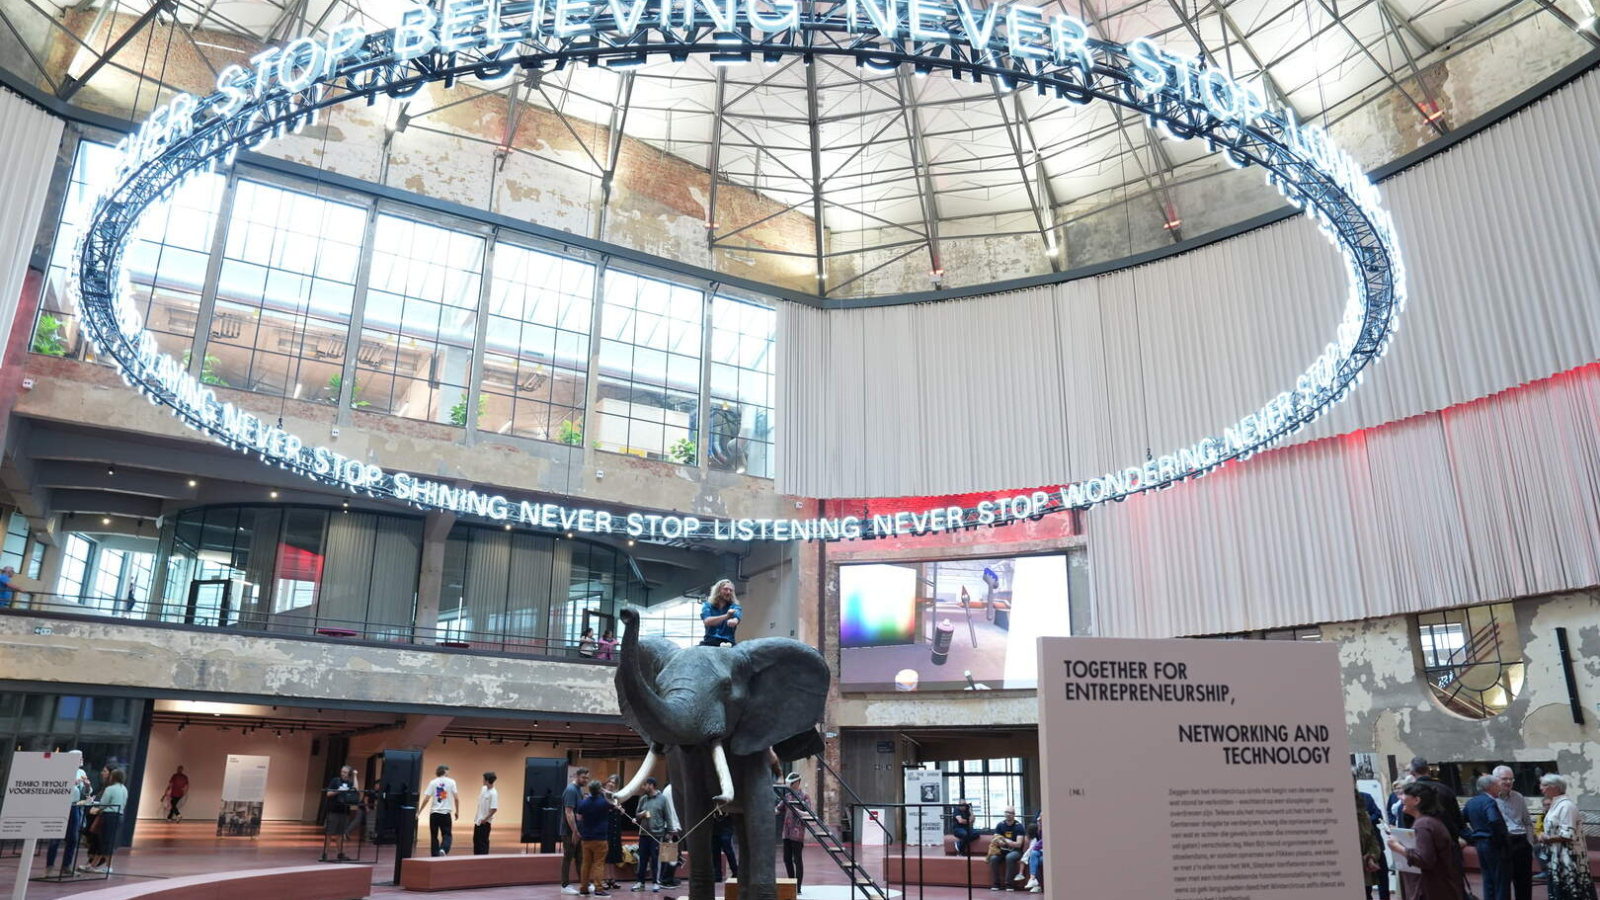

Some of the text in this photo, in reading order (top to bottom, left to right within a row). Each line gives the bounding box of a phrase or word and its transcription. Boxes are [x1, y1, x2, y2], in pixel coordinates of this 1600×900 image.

[211, 20, 366, 118] STOP
[394, 0, 1268, 126] BELIEVING NEVER STOP
[221, 401, 303, 466] NEVER
[312, 445, 385, 488] STOP
[392, 472, 509, 522] SHINING
[519, 500, 613, 534] NEVER
[626, 512, 701, 539] STOP
[713, 514, 861, 541] LISTENING
[872, 505, 965, 537] NEVER
[976, 490, 1050, 525] STOP
[1060, 437, 1219, 509] WONDERING
[1222, 390, 1295, 455] NEVER
[1063, 659, 1188, 680] TOGETHER FOR
[1065, 682, 1236, 706] ENTREPRENEURSHIP,
[1178, 724, 1330, 743] NETWORKING AND
[1222, 746, 1331, 765] TECHNOLOGY
